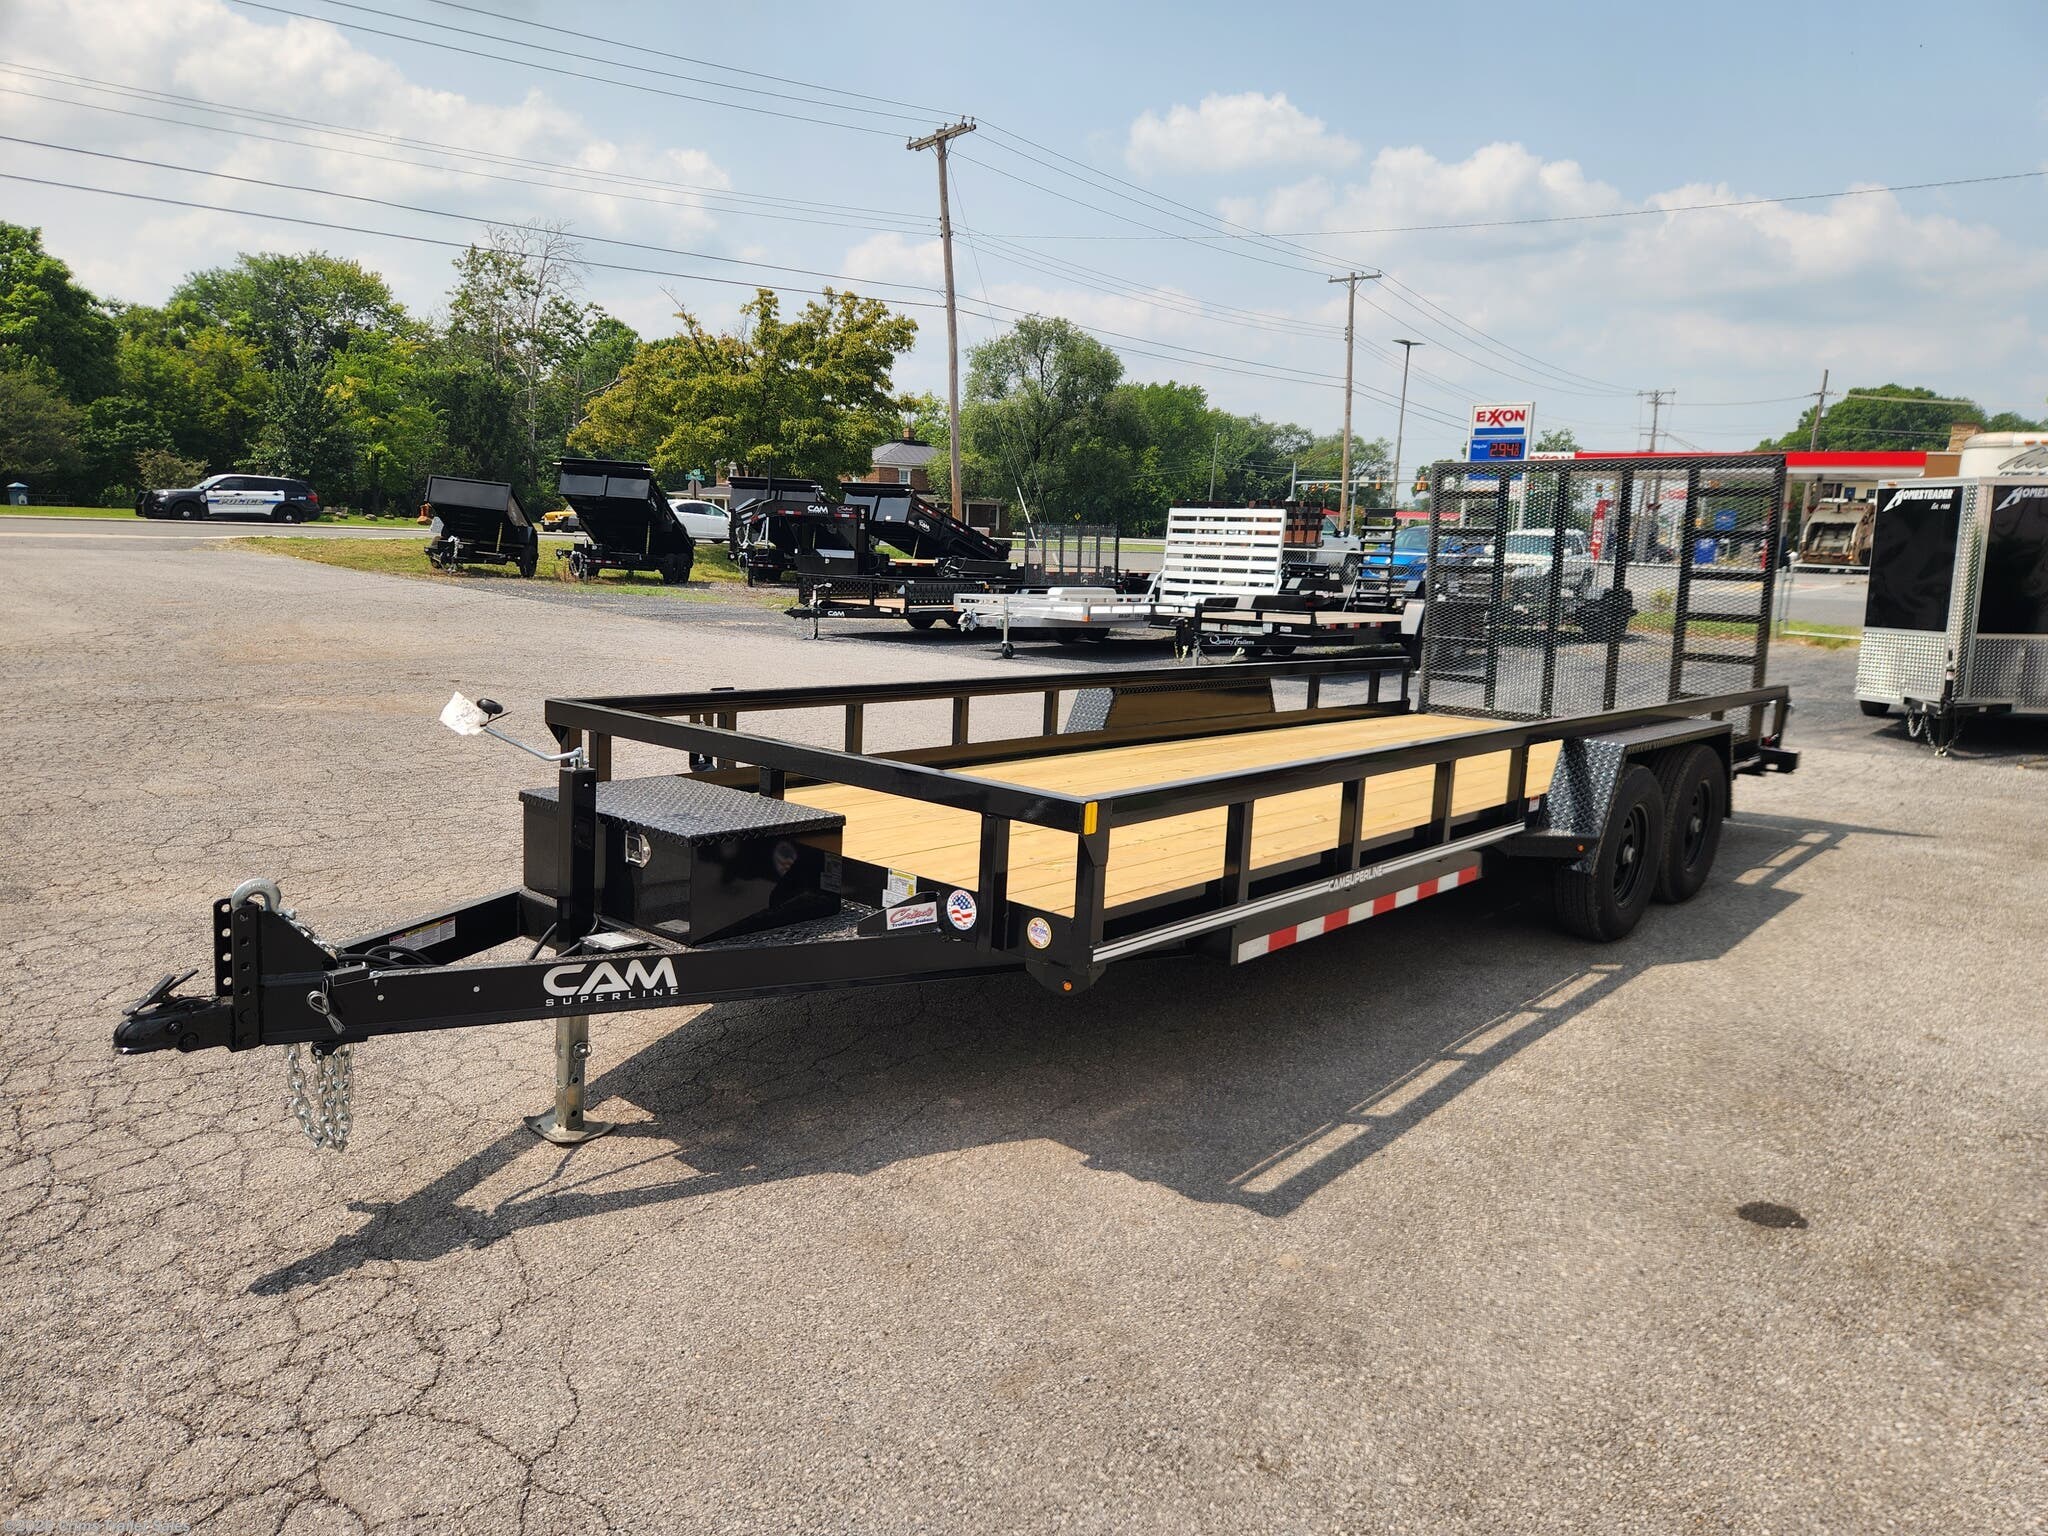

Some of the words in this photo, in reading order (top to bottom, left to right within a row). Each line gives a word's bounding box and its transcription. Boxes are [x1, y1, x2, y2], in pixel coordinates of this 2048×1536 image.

[1476, 409, 1526, 427] EXXON
[218, 498, 266, 506] POLICE
[1882, 488, 1954, 512] HOMESTEADER
[807, 505, 829, 514] CAM
[1209, 634, 1233, 645] Quality
[543, 957, 678, 996] CAM
[545, 987, 679, 1006] SUPERLINE
